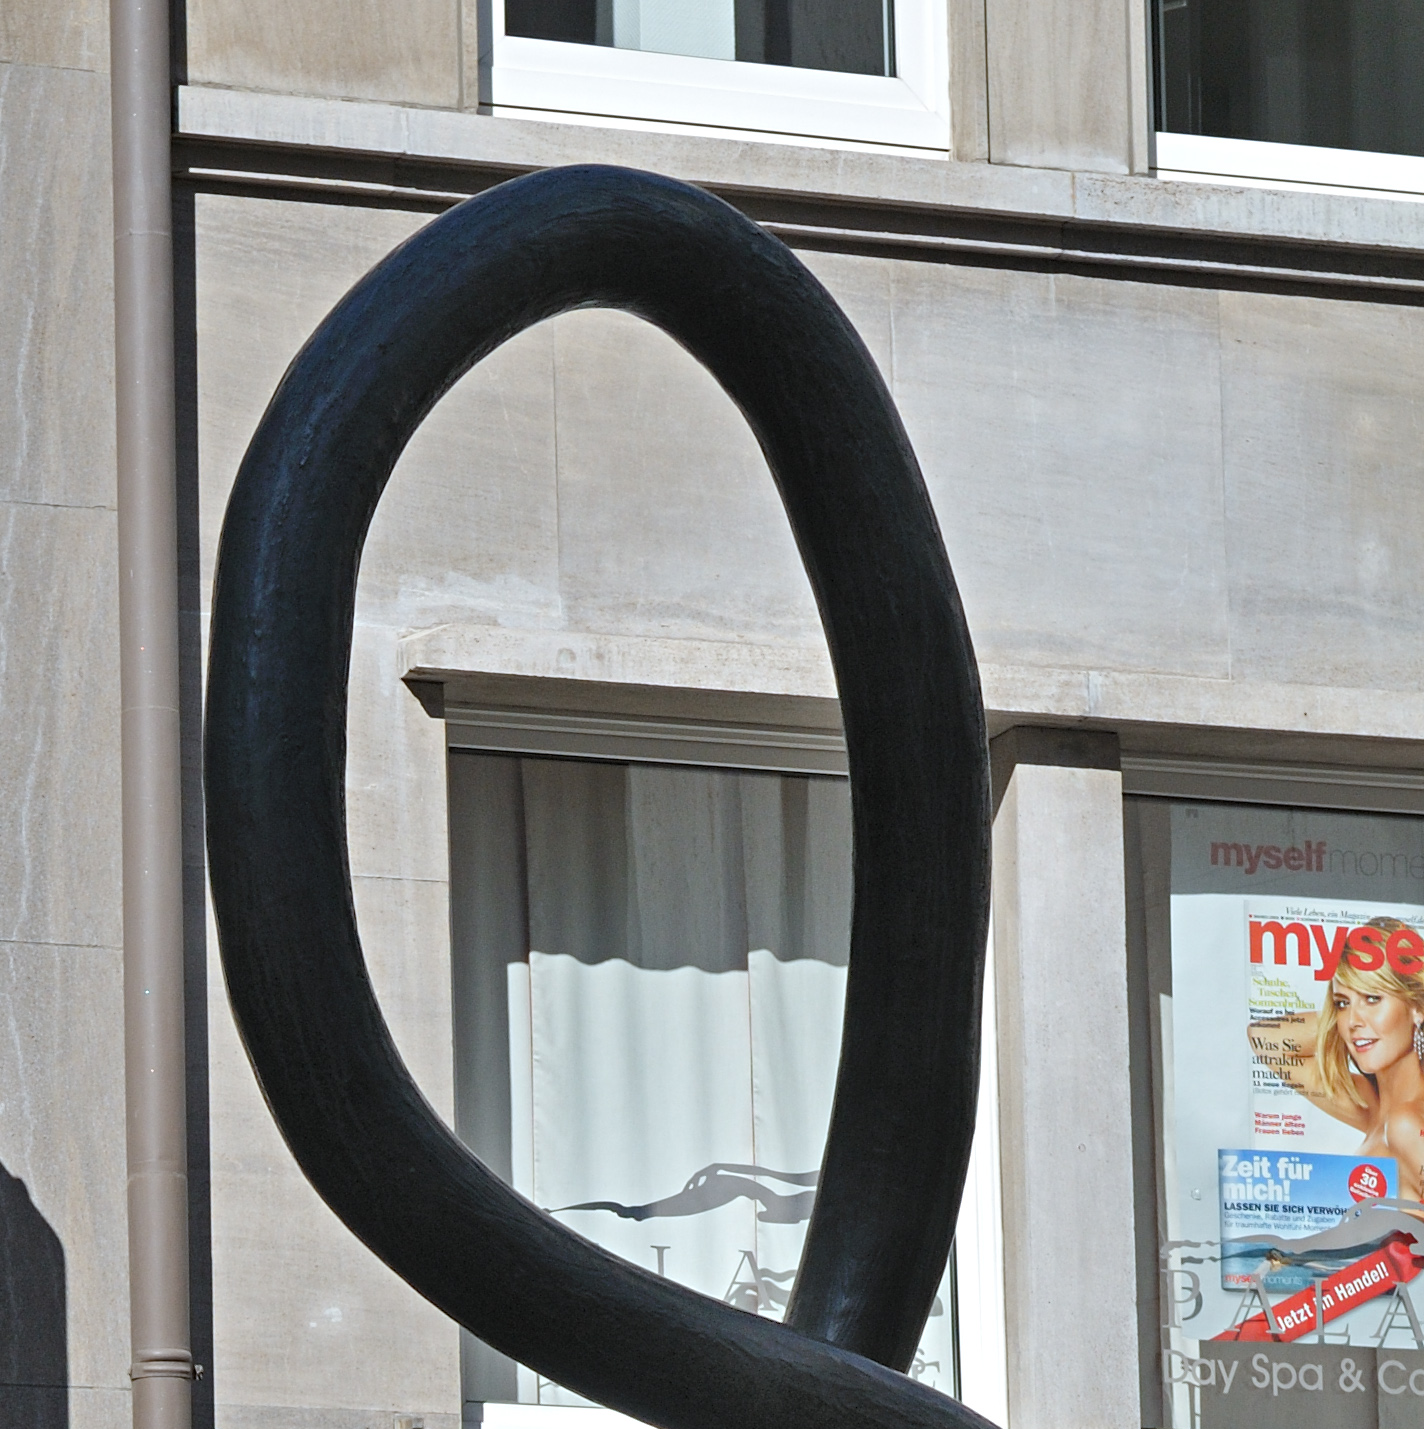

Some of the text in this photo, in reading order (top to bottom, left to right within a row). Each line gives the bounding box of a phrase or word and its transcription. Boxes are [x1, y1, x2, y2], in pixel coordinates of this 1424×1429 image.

[1210, 841, 1326, 874] myself
[1252, 1036, 1302, 1053] Was Sie
[1252, 1053, 1306, 1067] attraktiv
[1252, 1069, 1292, 1081] macht
[1221, 1155, 1313, 1181] Zeit für
[1223, 1178, 1291, 1202] mich!
[1360, 1173, 1377, 1188] 30
[1224, 1202, 1262, 1211] LASSEN
[1264, 1204, 1279, 1212] SIE
[1283, 1205, 1304, 1214] SICH
[1276, 1302, 1314, 1333] Jetzt
[1334, 1261, 1390, 1301] Handel!
[1162, 1348, 1240, 1395] Day
[1251, 1353, 1324, 1397] Spa
[1339, 1357, 1366, 1393] &
